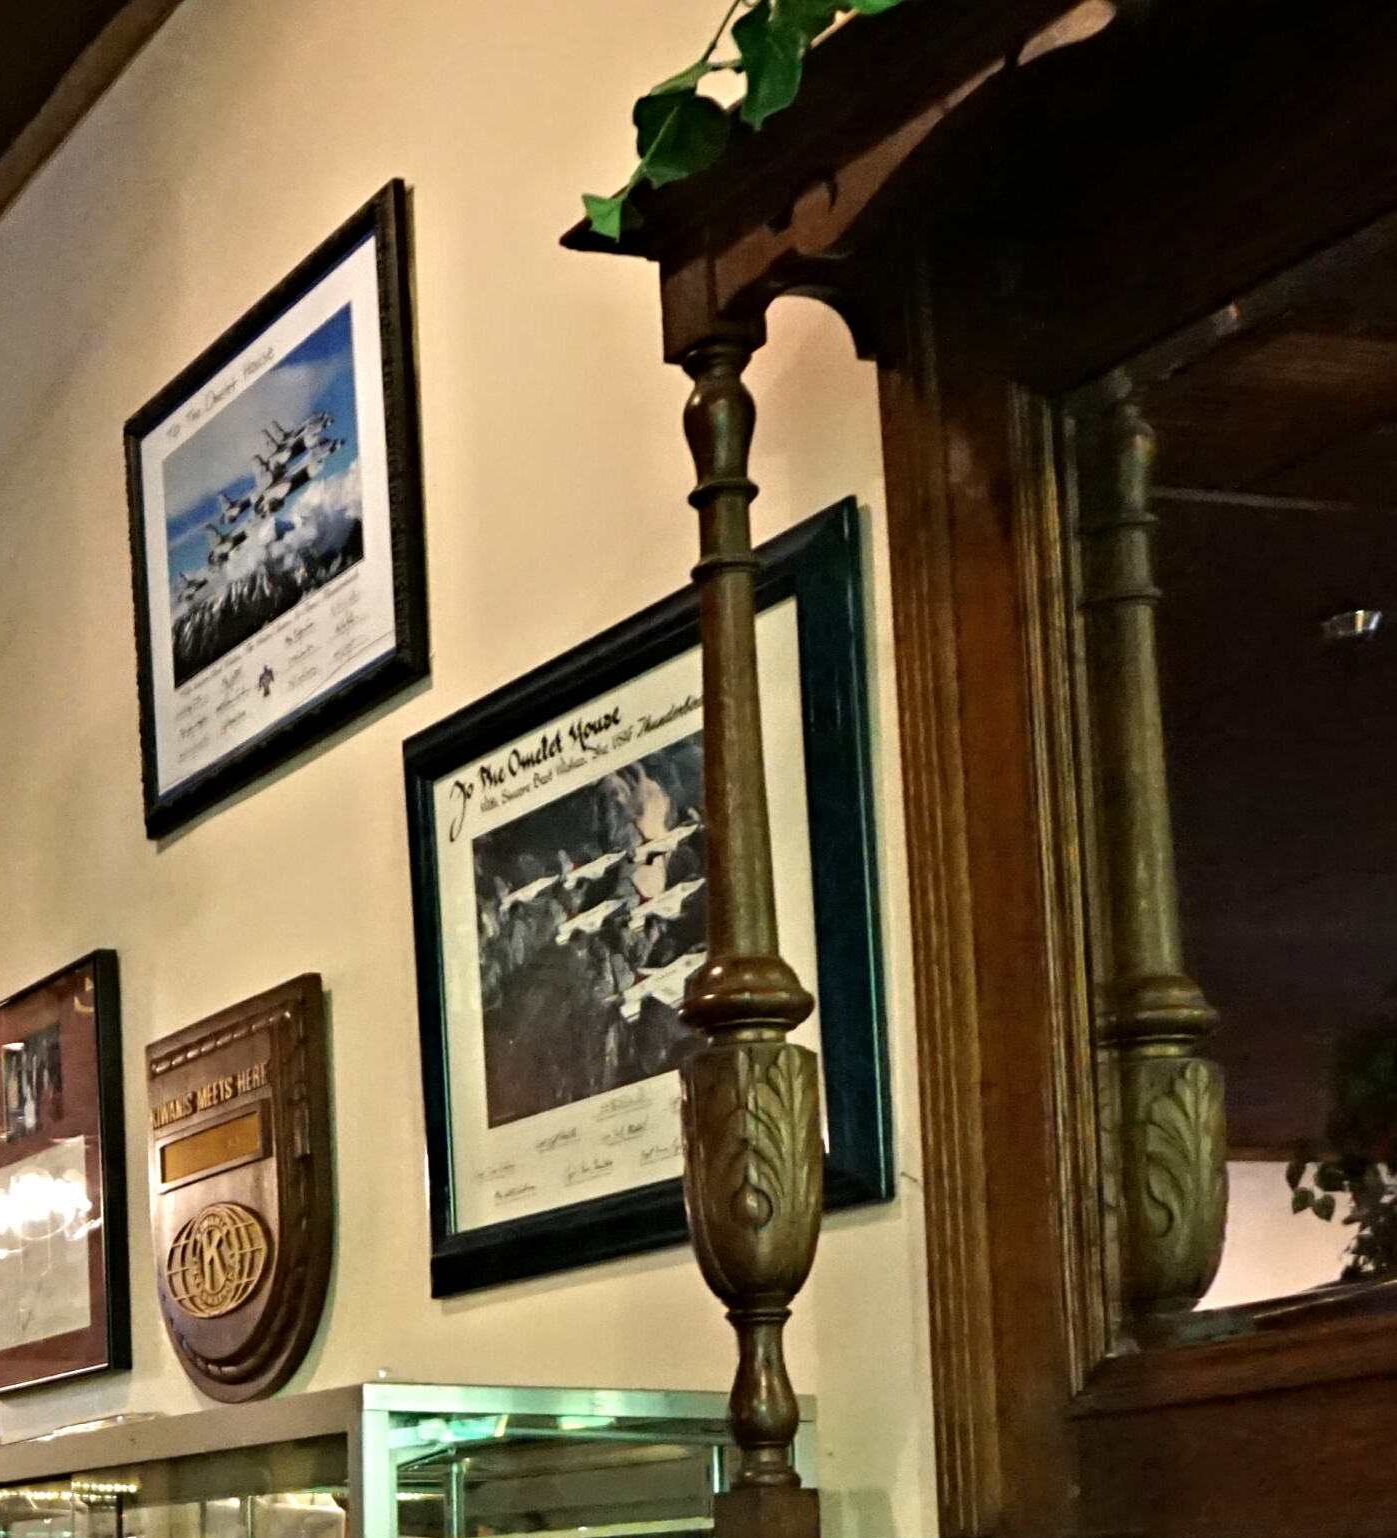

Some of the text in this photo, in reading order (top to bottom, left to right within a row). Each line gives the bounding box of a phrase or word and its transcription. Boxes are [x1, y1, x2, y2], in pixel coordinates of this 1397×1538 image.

[507, 730, 563, 777] Omelet
[197, 1077, 233, 1110] MEETS
[237, 1062, 267, 1094] HERE
